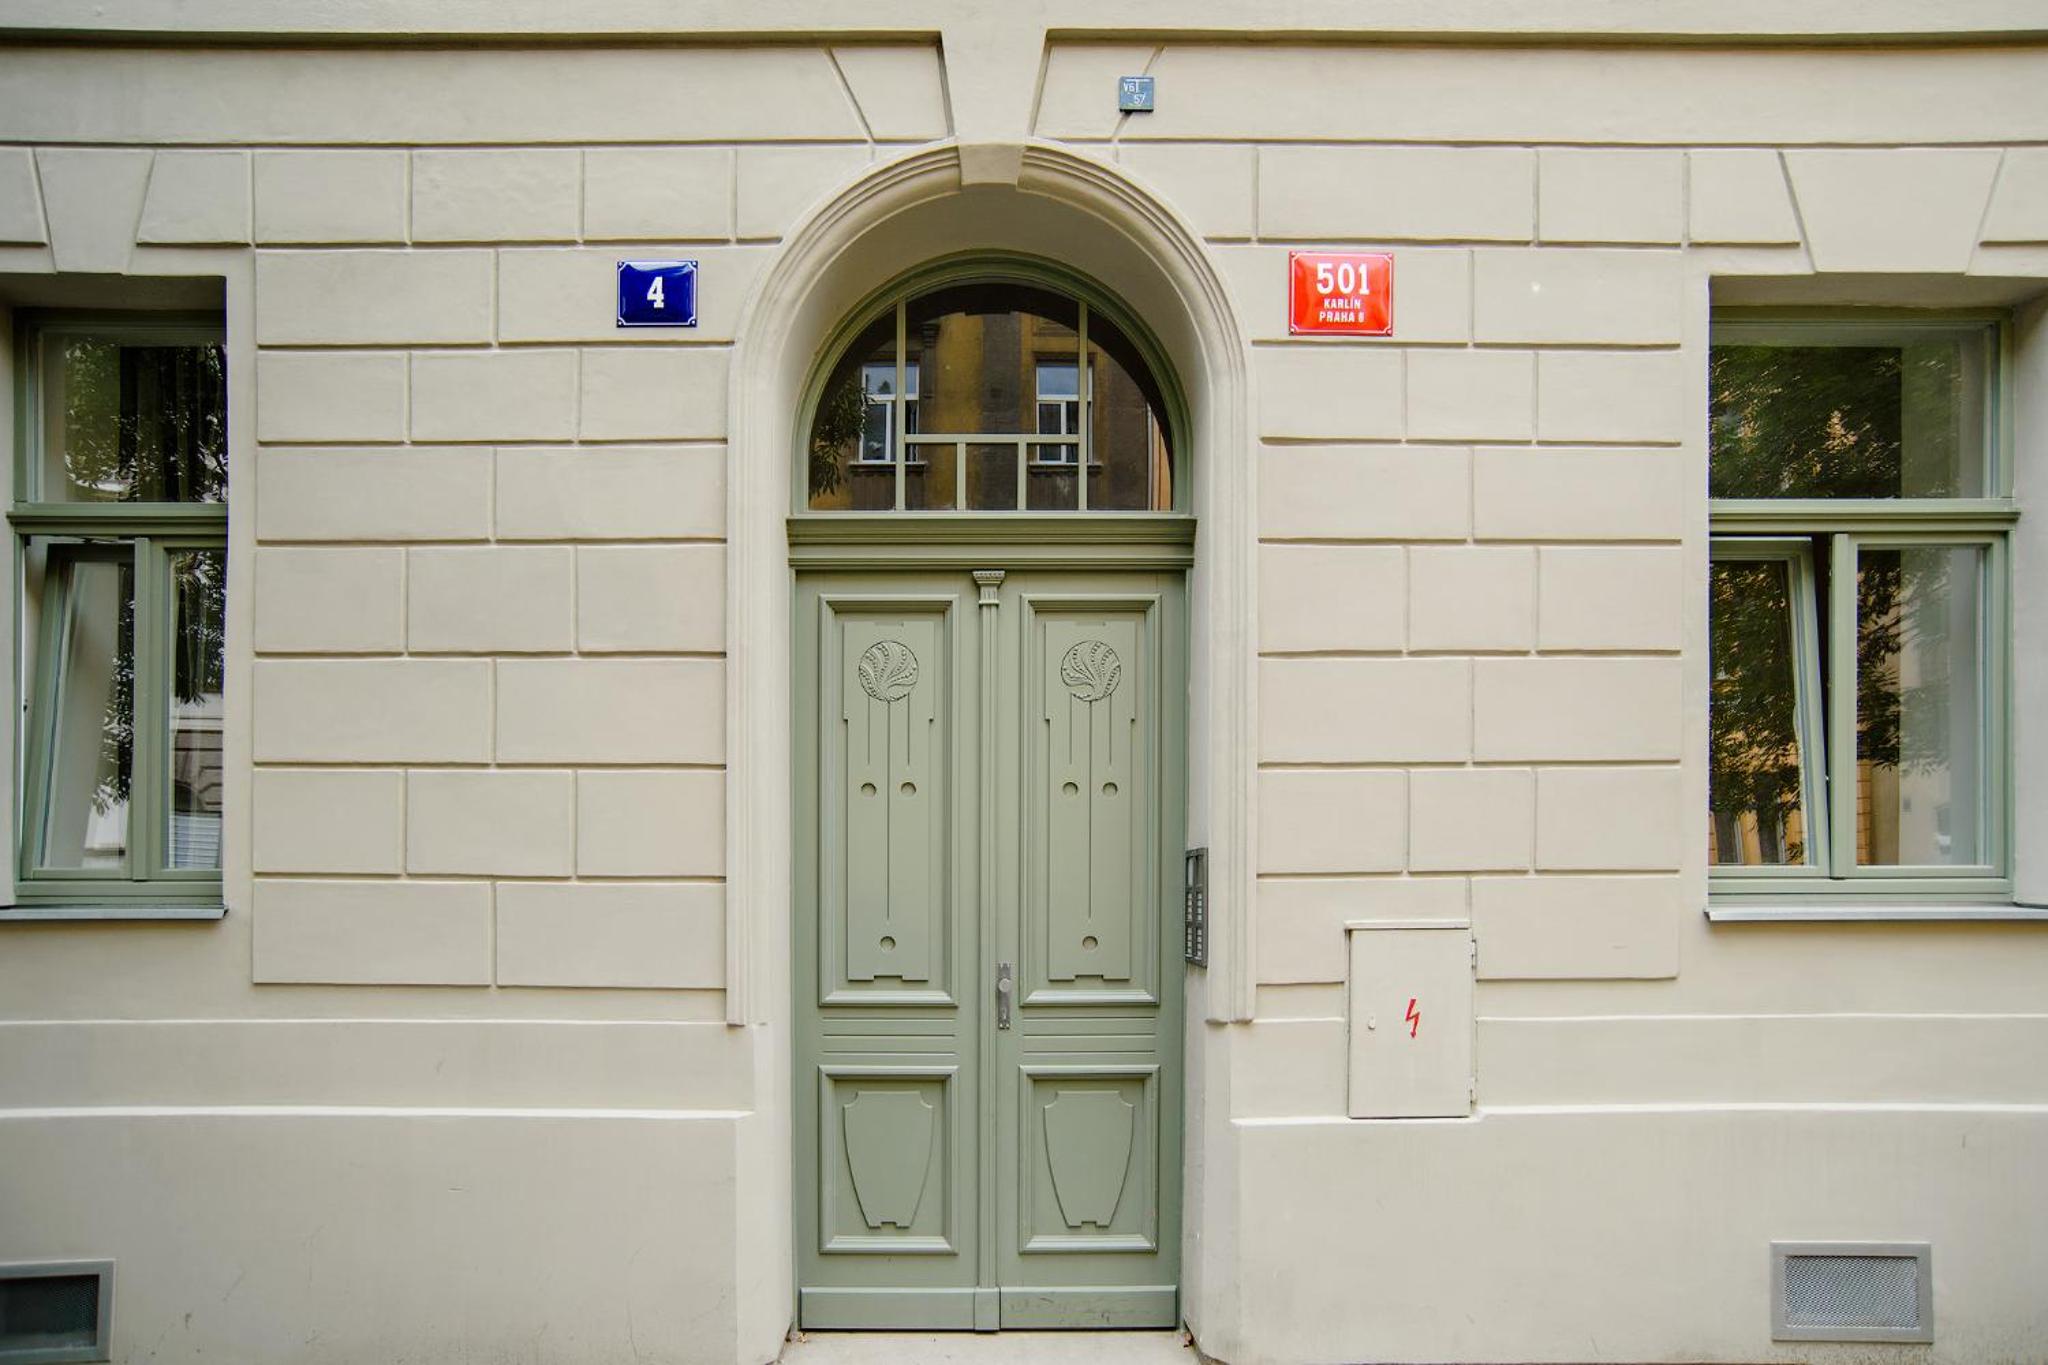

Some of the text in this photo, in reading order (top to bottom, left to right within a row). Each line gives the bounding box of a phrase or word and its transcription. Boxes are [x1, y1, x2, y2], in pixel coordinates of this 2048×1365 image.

[1316, 262, 1370, 295] 501
[646, 276, 665, 309] 4
[1324, 296, 1361, 309] KARLÍN
[1319, 311, 1365, 323] PRAHA 8
